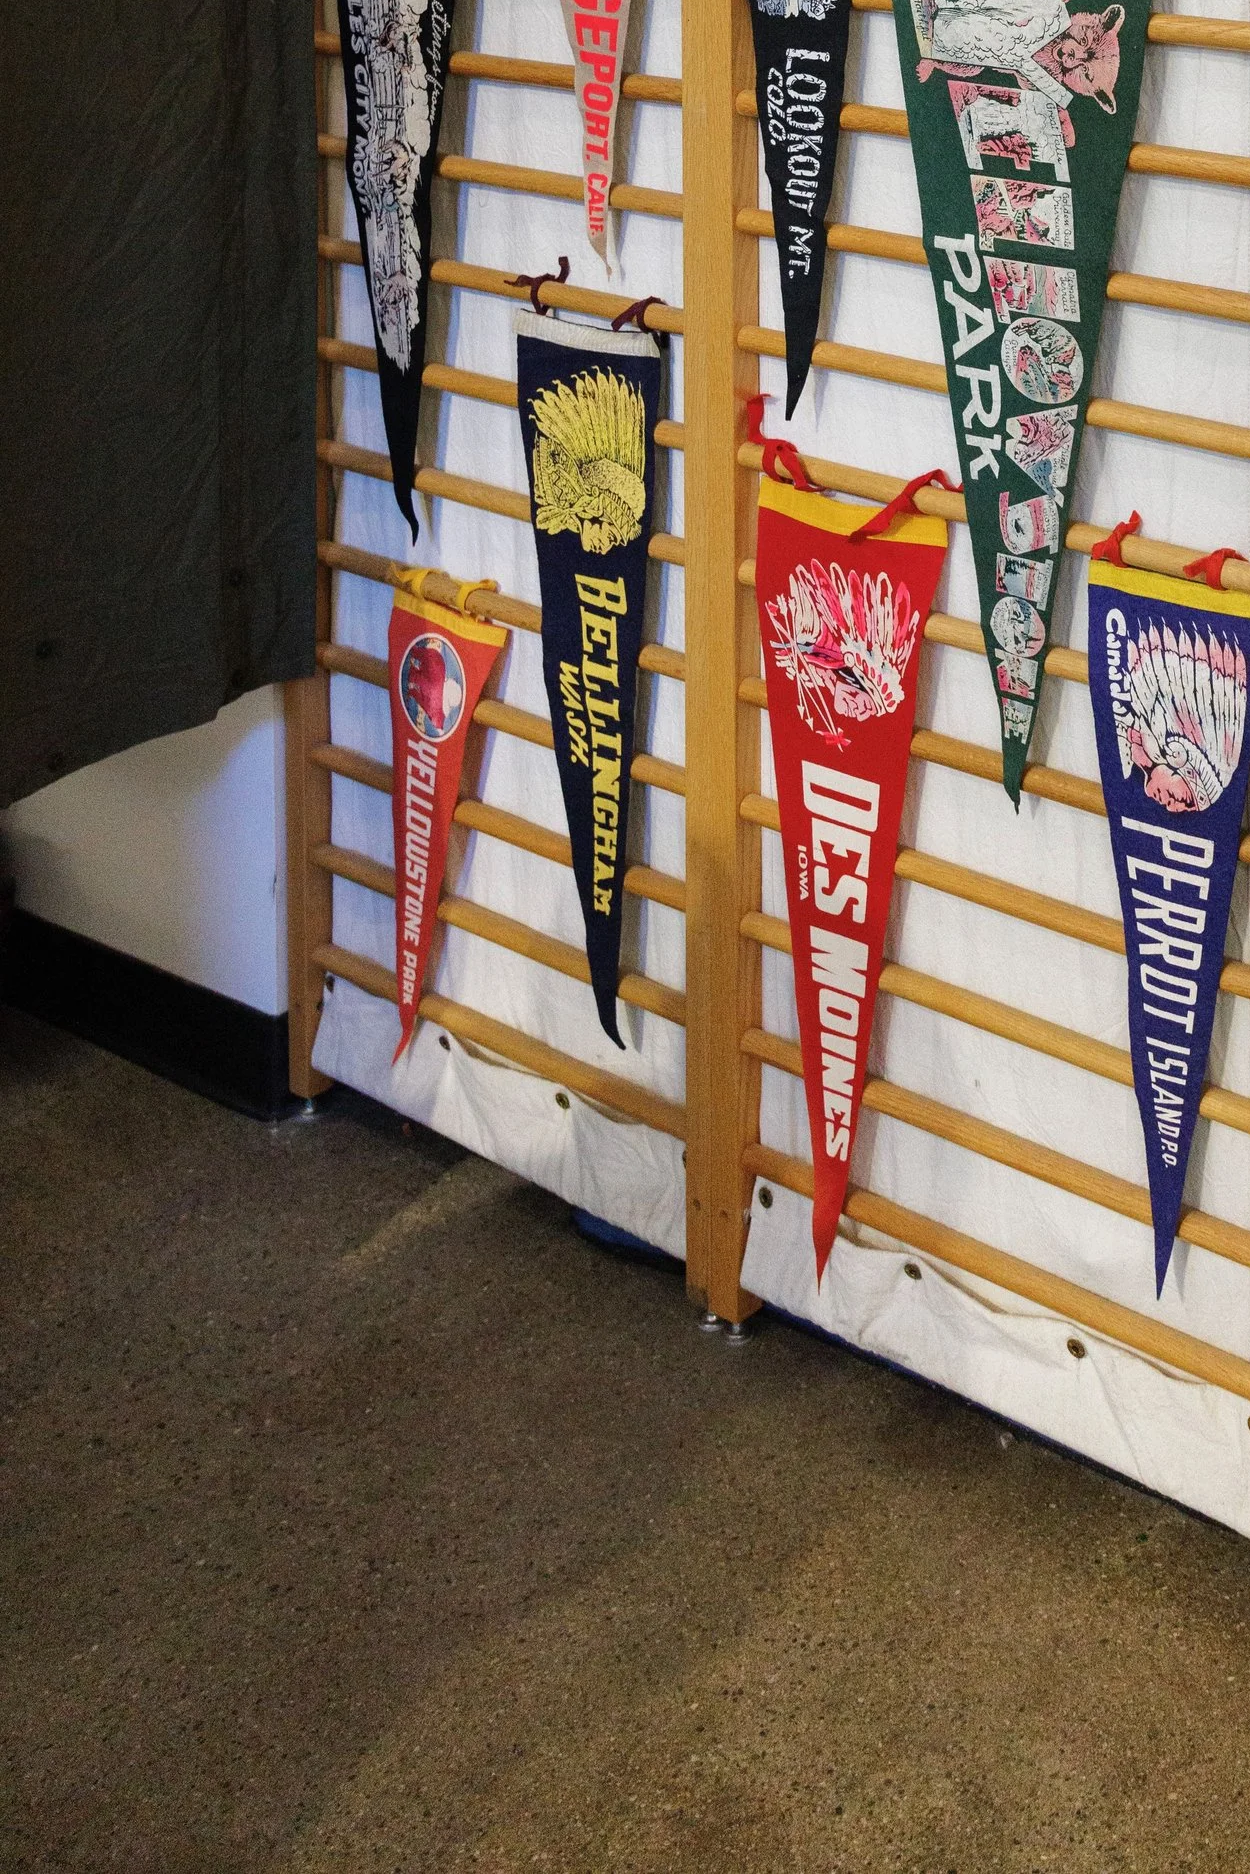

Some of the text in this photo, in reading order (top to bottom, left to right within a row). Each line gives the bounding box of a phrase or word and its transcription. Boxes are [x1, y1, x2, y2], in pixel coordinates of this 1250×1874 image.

[354, 64, 372, 133] CITY
[785, 47, 831, 280] LOOKOUT MT.
[933, 231, 1002, 483] PARK
[558, 661, 589, 767] WASH.
[575, 576, 629, 917] BELLINGHAM
[401, 737, 438, 1005] YELLOWSTONE PARK
[796, 844, 809, 901] IOWA
[801, 759, 881, 1163] DES MOINES
[1121, 815, 1214, 1035] PERROT
